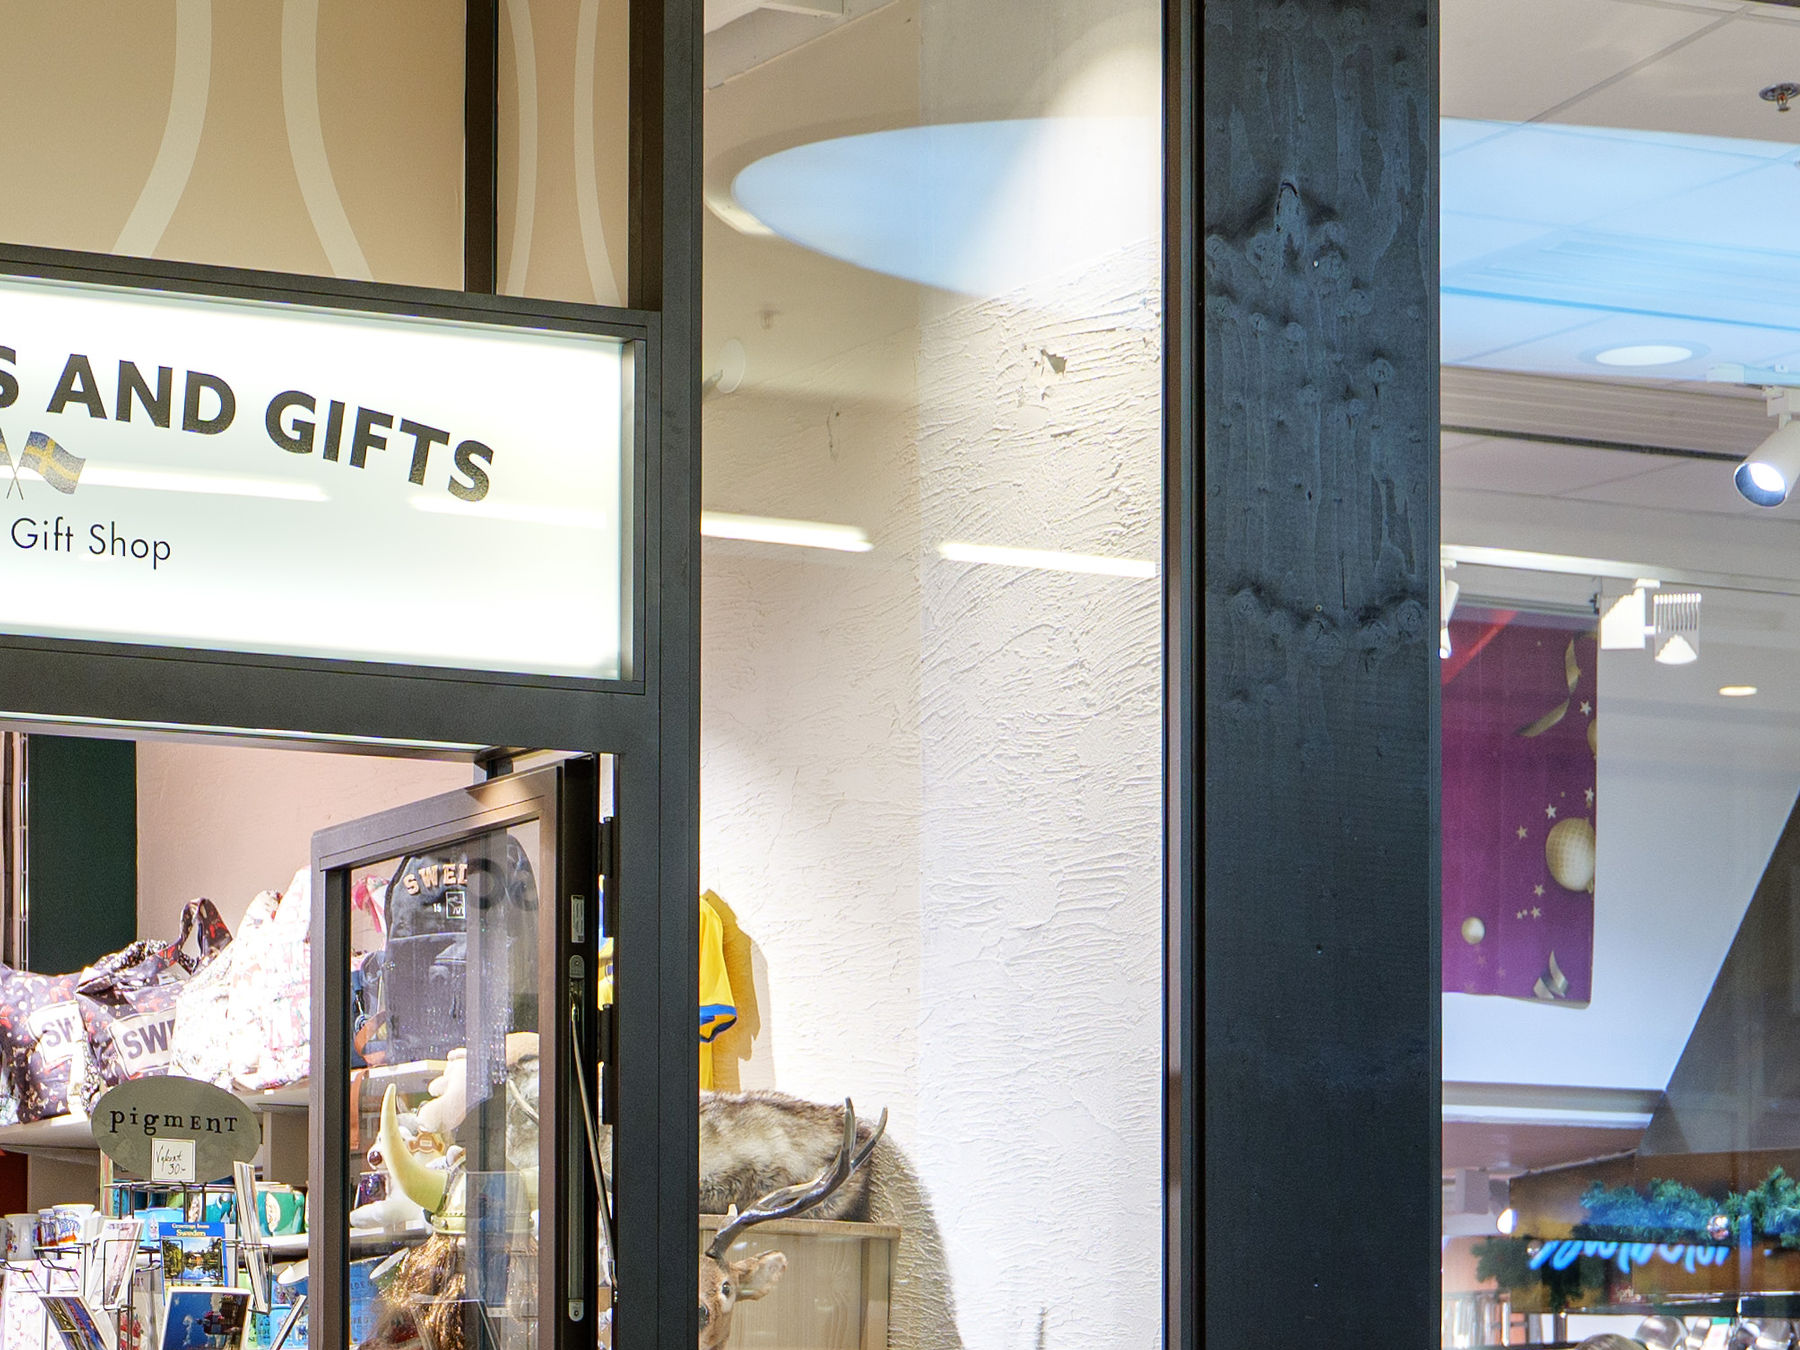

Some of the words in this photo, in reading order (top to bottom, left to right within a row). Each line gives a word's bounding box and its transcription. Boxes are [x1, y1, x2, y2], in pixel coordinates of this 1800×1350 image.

[46, 353, 237, 437] AND
[264, 389, 494, 503] GIFTS
[11, 516, 75, 553] Gift
[89, 521, 172, 570] Shop
